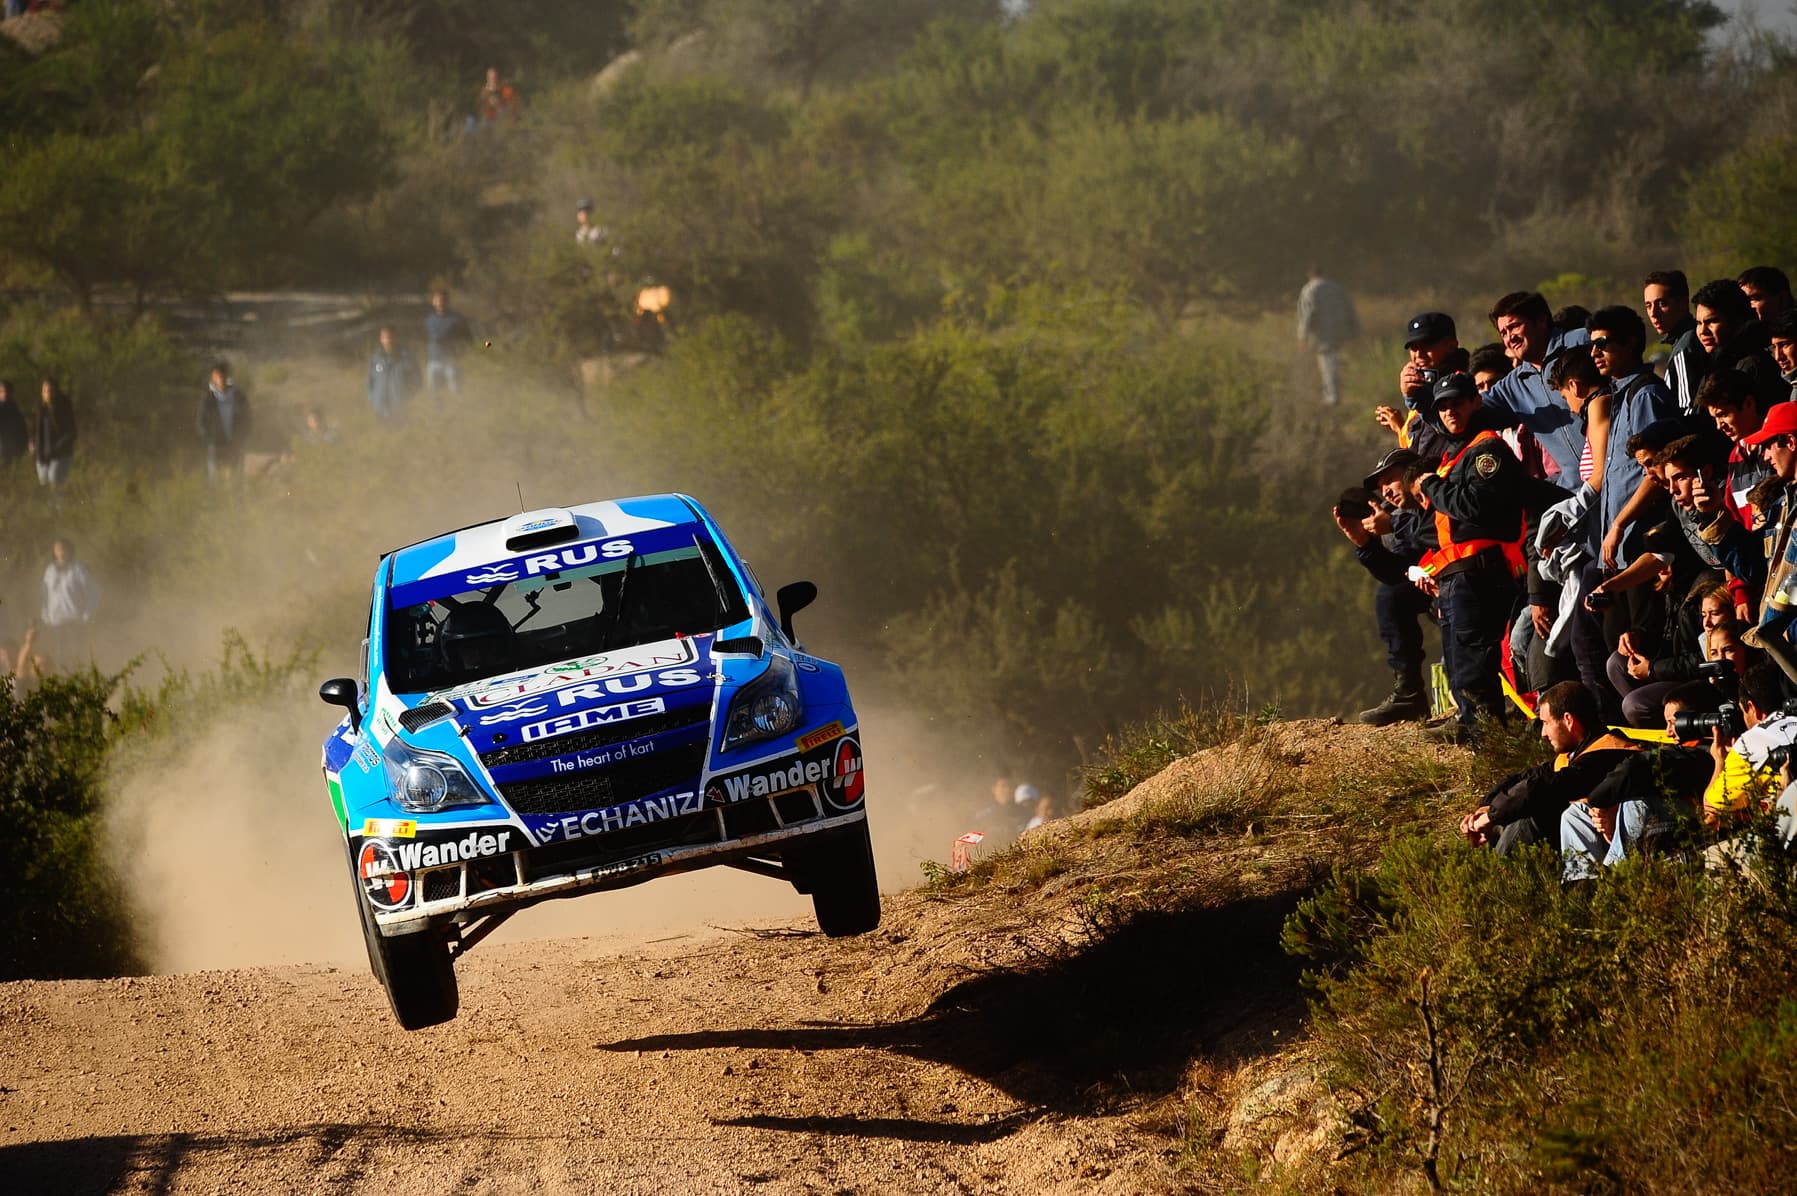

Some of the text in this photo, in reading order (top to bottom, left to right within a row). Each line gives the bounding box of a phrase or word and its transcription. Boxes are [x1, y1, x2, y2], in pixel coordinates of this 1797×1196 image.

[525, 539, 634, 575] RUS
[557, 668, 701, 707] RUS
[529, 699, 662, 737] IAME
[800, 723, 842, 750] PIRELLI
[550, 741, 655, 773] The heart of kart
[724, 757, 830, 802] Wander
[560, 791, 698, 840] ECHANIZ
[400, 831, 510, 871] Wander
